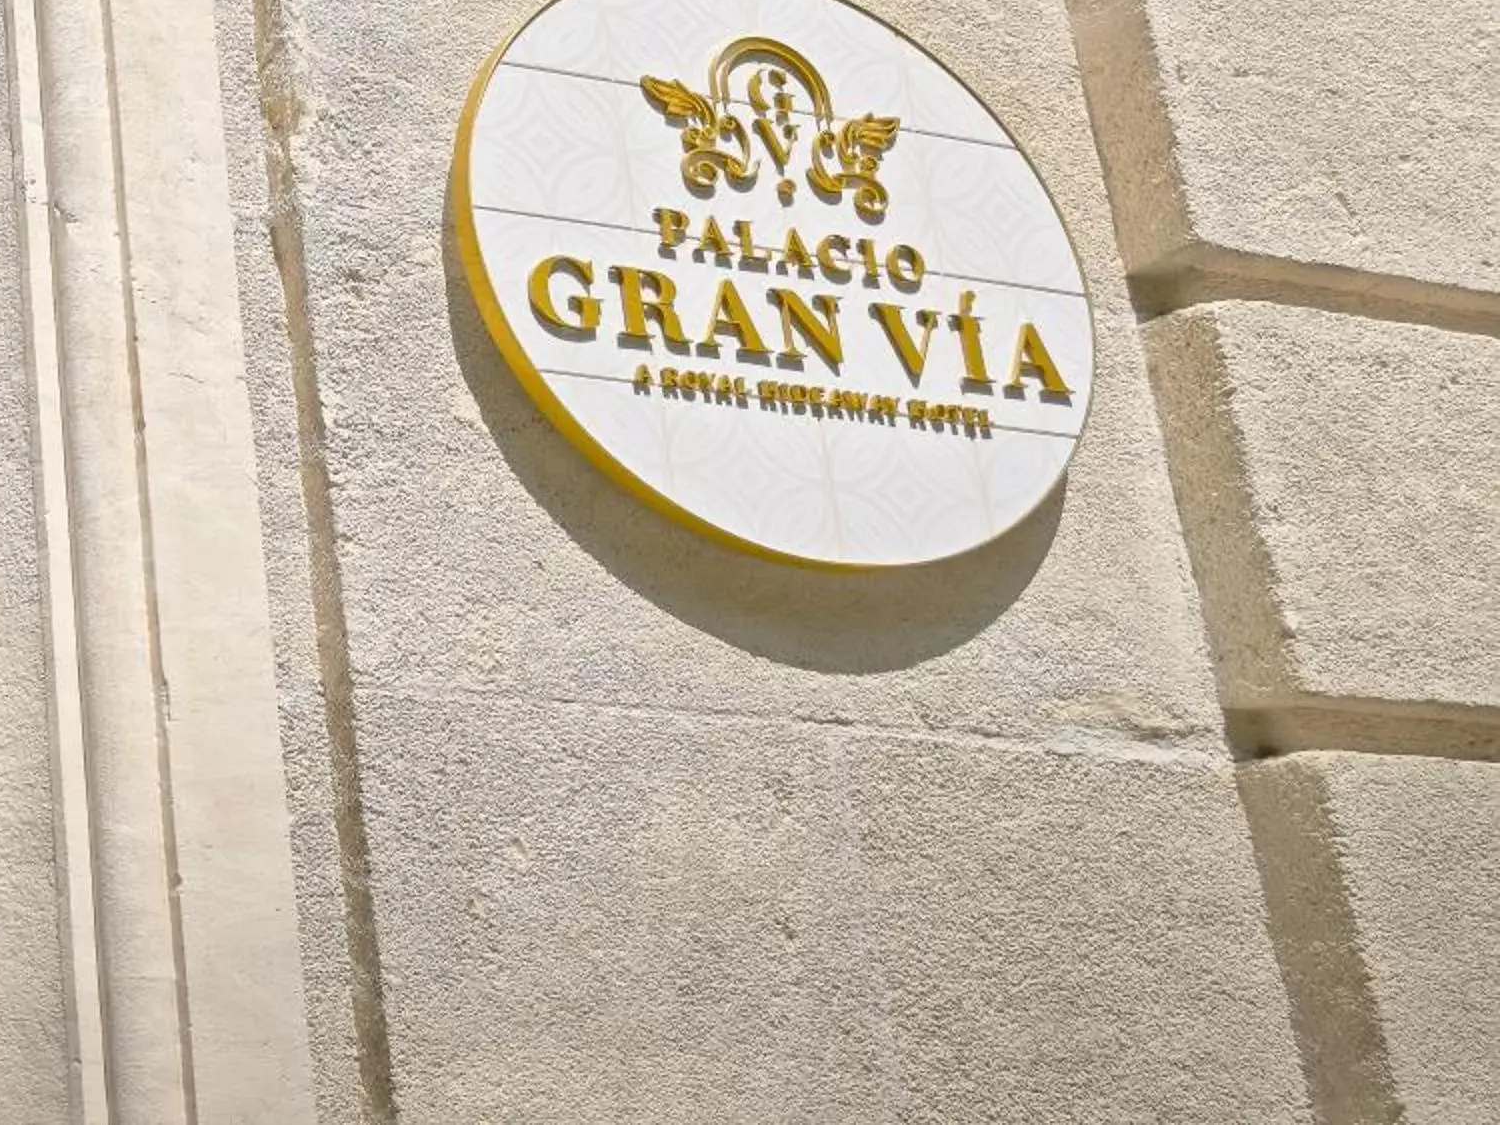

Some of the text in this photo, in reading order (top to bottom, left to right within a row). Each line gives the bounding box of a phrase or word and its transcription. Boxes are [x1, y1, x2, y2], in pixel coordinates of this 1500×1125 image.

[654, 207, 926, 287] PALACIO
[527, 254, 1074, 397] GRAN VÍA
[659, 366, 747, 402] ROYAL
